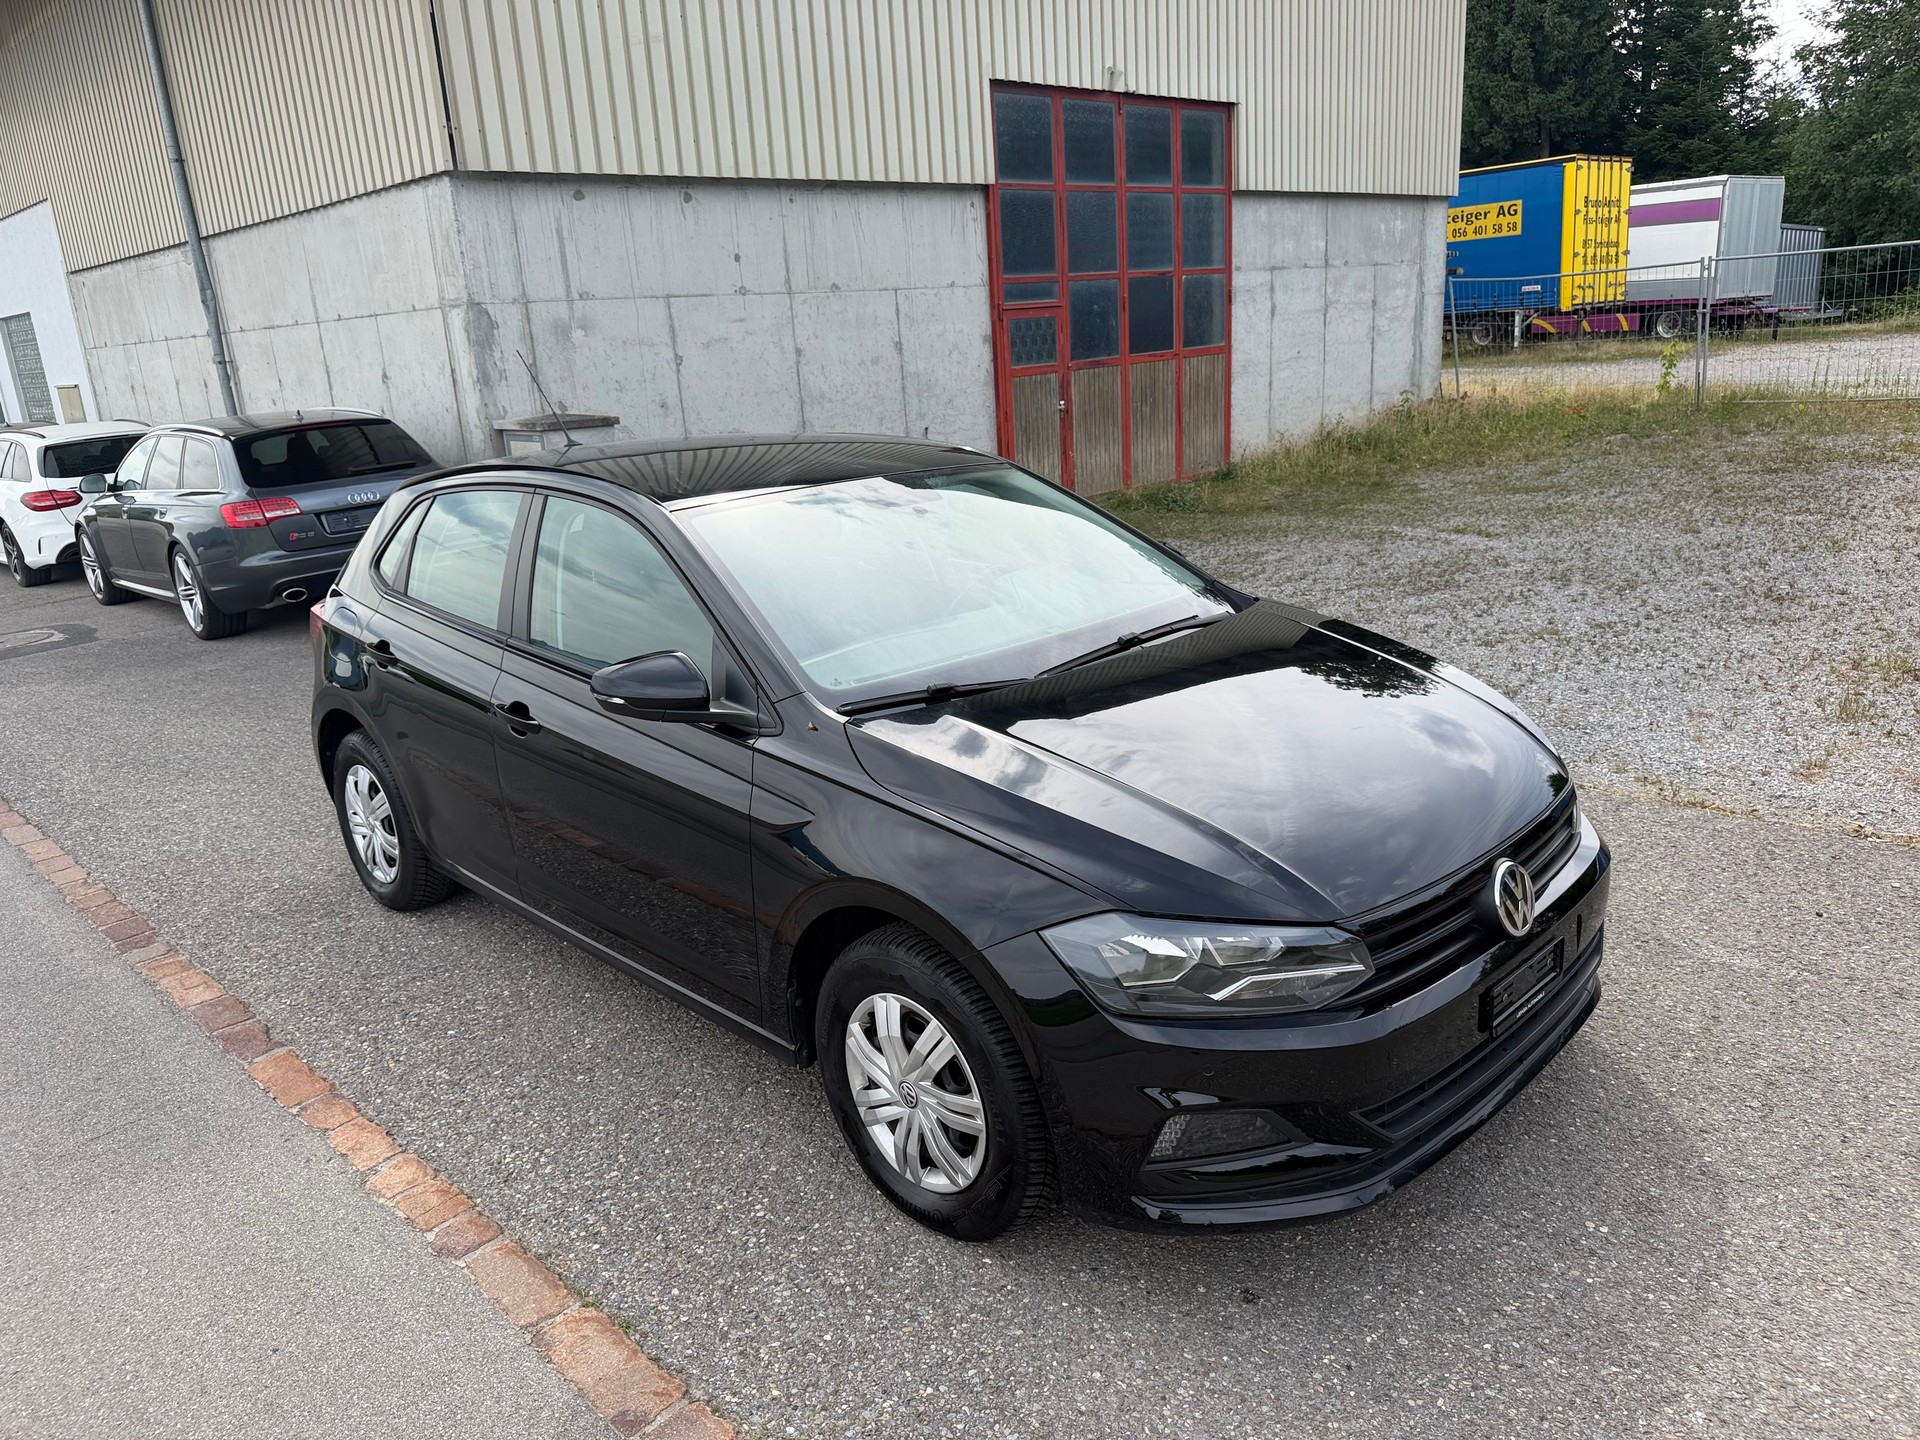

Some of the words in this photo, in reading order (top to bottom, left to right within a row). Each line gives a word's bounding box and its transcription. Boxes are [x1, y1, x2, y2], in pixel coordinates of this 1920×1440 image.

[1496, 203, 1518, 218] AG
[1451, 227, 1468, 238] 056
[1472, 225, 1487, 236] 401
[1492, 223, 1503, 234] 58
[1506, 221, 1518, 232] 58
